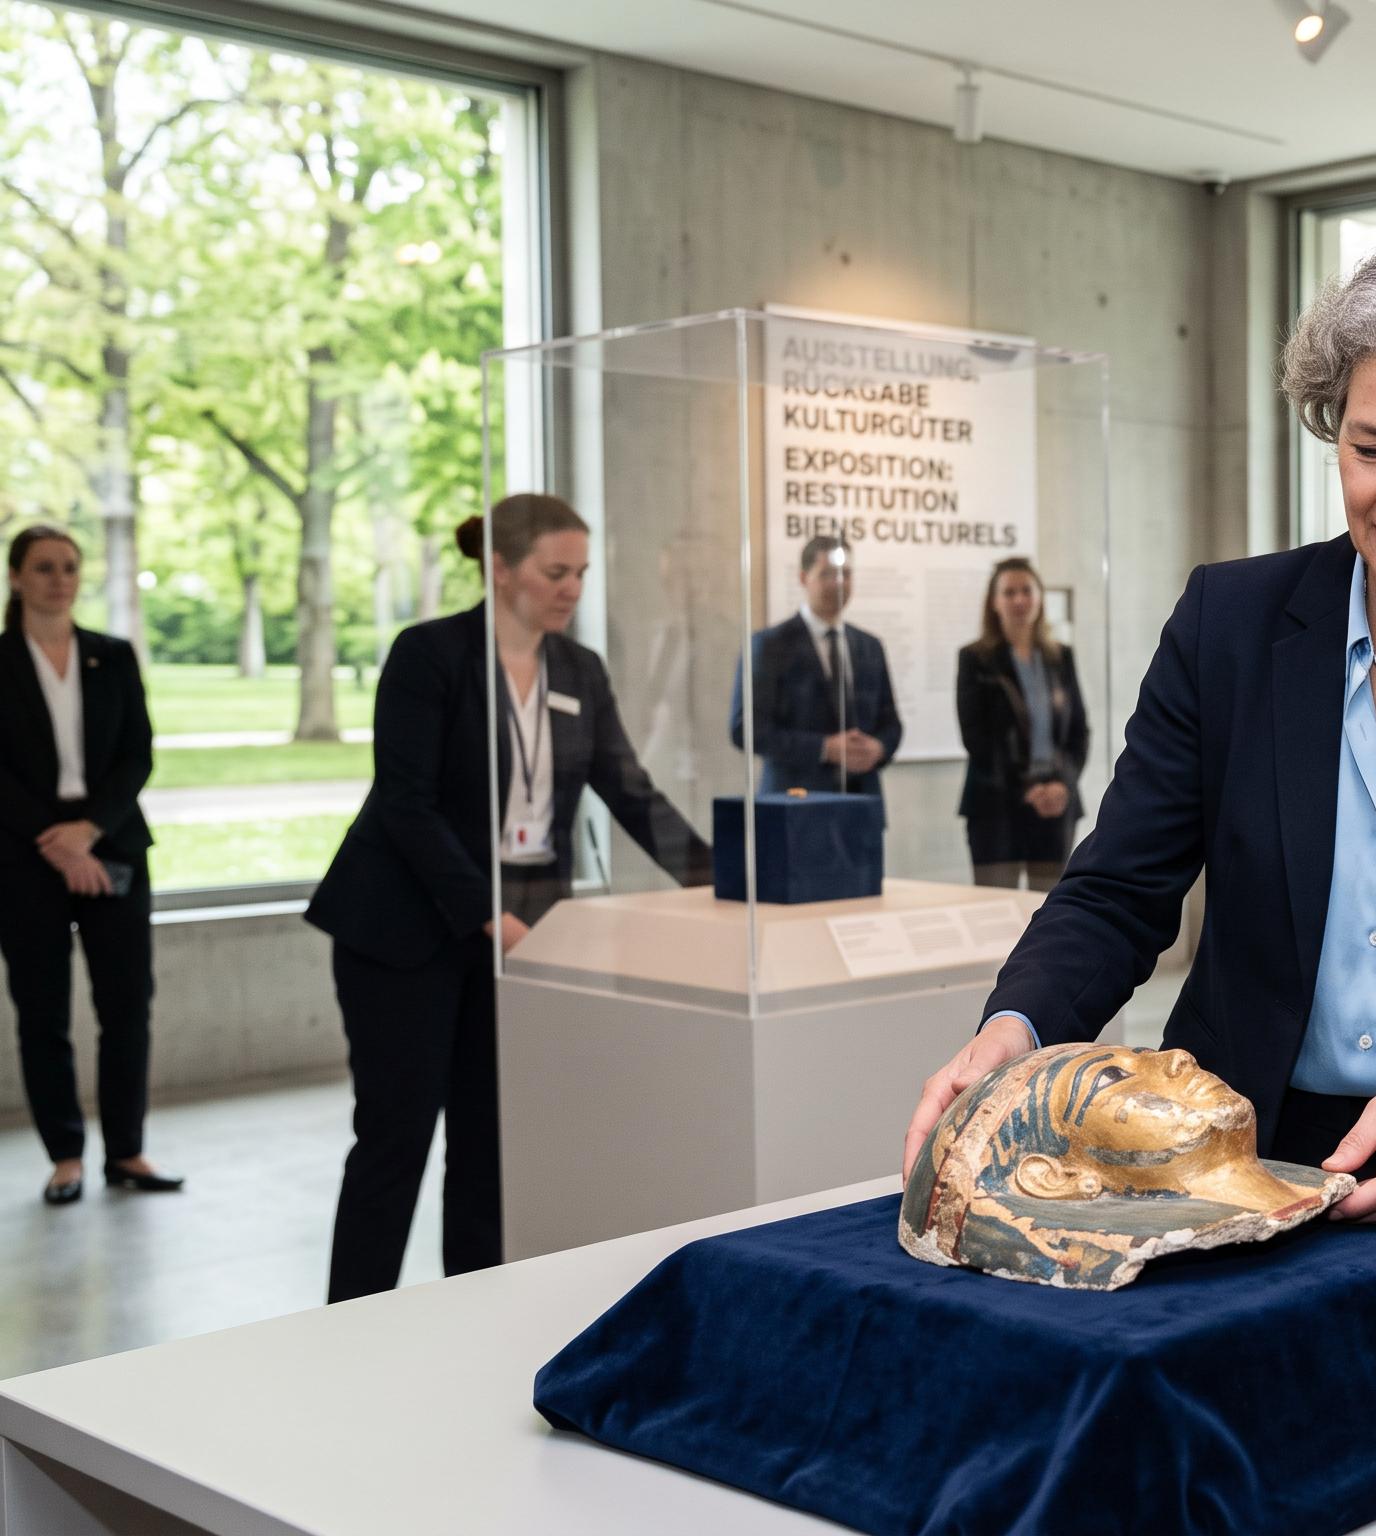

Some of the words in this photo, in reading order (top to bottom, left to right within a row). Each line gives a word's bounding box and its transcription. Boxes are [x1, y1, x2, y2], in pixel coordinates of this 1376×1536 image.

[783, 364, 930, 407] RÜCKGABE
[783, 404, 973, 442] KULTURGÜTER
[784, 449, 953, 481] EXPOSITION:
[784, 481, 959, 513] RESTITUTION
[785, 514, 867, 541] BIENS
[873, 518, 1018, 547] CULTURELS
